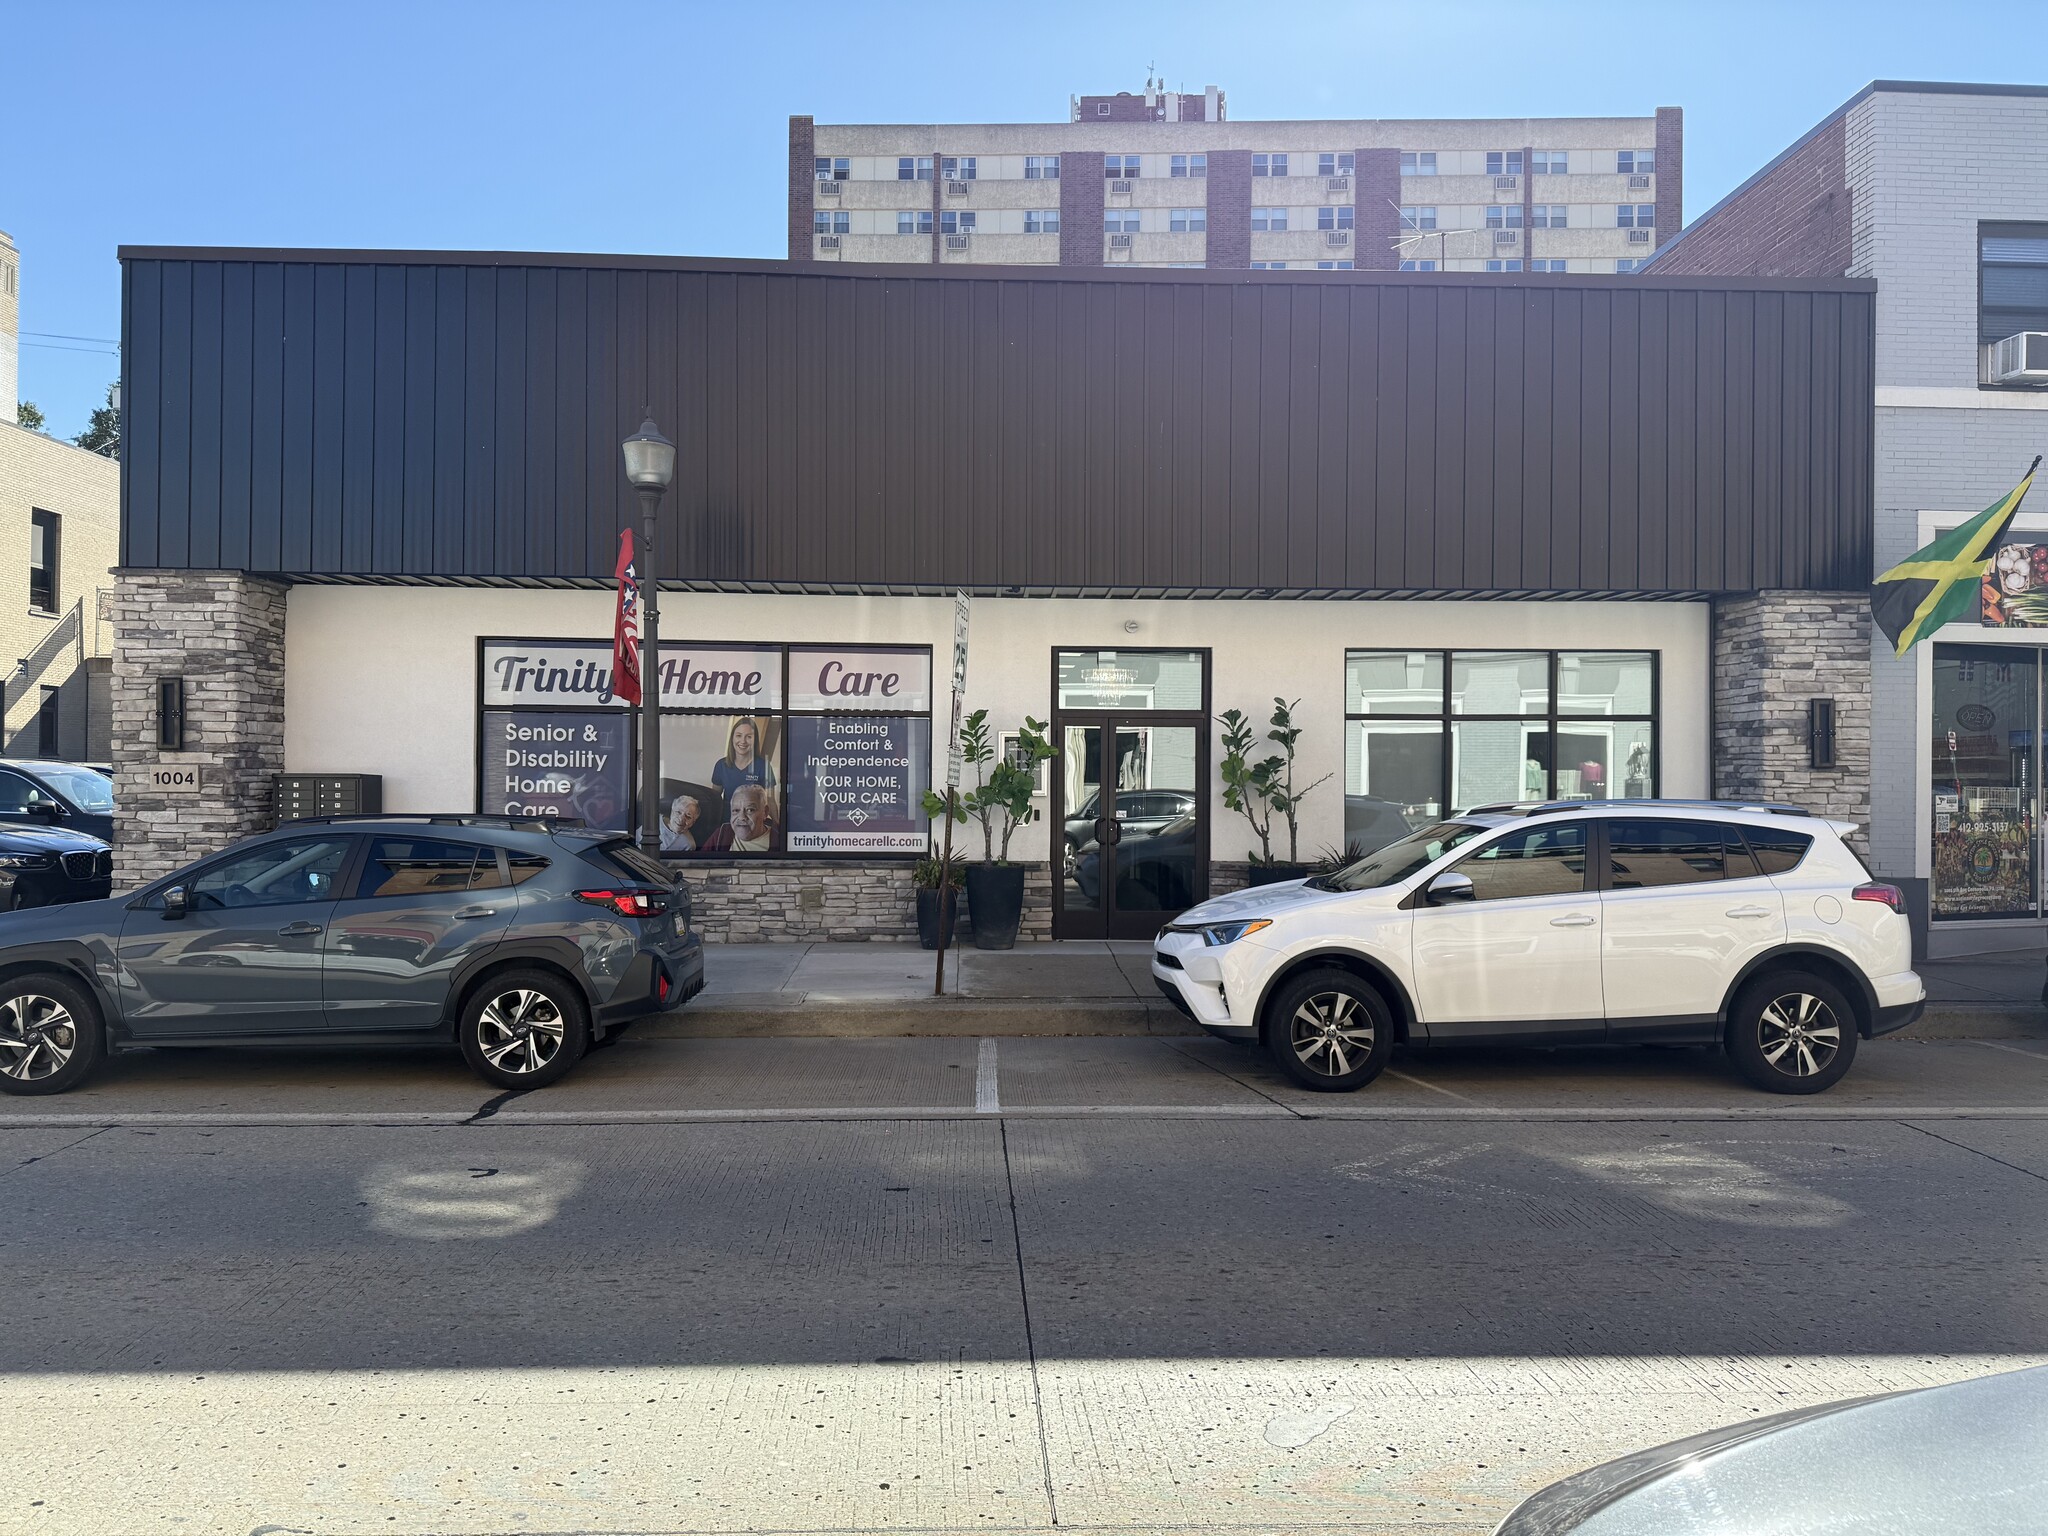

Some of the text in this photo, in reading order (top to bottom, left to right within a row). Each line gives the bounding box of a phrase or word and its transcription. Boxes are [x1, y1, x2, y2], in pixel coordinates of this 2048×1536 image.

[956, 600, 969, 623] SPEED
[956, 621, 967, 641] LIMIT
[954, 643, 966, 682] 25
[494, 656, 614, 704] Trinity
[659, 659, 762, 695] Home
[818, 660, 900, 697] Care
[1961, 711, 1993, 724] OPEN
[505, 723, 598, 742] Senior &
[829, 722, 888, 737] Enabling
[824, 738, 893, 751] Comfort &
[505, 749, 608, 771] Disability
[807, 755, 909, 768] Independence
[153, 771, 195, 785] 1004
[505, 775, 571, 794] Home
[815, 776, 902, 789] YOUR HOME,
[820, 792, 897, 804] YOUR CARE
[504, 801, 560, 817] Care
[1957, 822, 2009, 832] 412-925-3137
[793, 835, 923, 848] trinityhomecarellc.com
